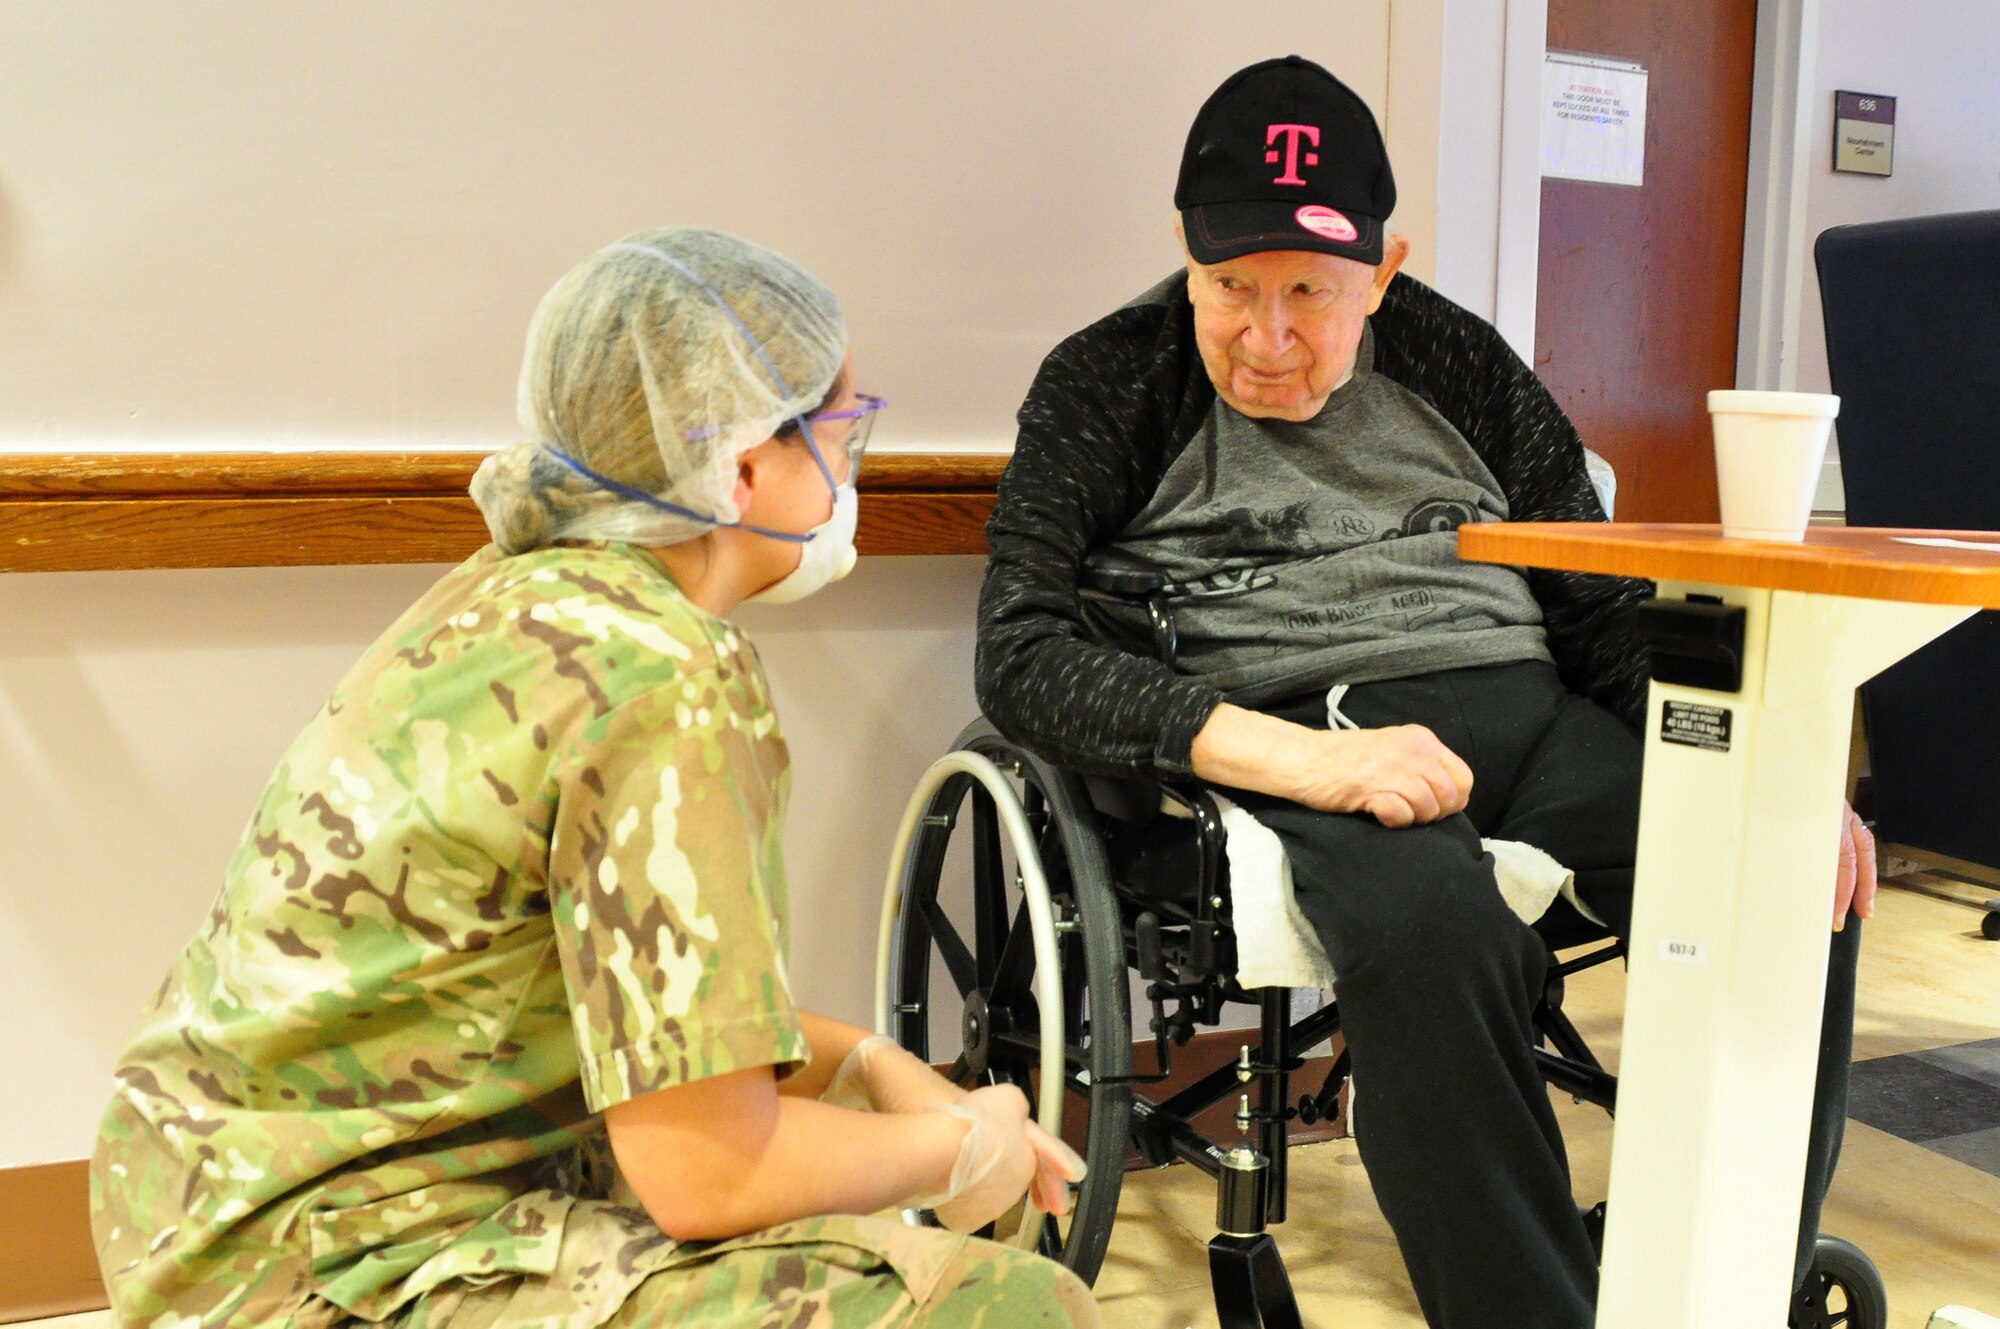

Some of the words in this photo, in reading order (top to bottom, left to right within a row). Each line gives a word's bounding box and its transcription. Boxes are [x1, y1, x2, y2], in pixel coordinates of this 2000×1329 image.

[1577, 94, 1594, 102] DOOR
[1595, 96, 1612, 104] MUST
[1552, 101, 1567, 109] KEPT
[1568, 103, 1591, 112] LOCKED
[1592, 105, 1600, 113] AT
[1557, 111, 1569, 119] FOR
[1265, 124, 1320, 186] T
[1391, 589, 1430, 610] AGED
[1693, 704, 1724, 716] CAPACITY
[1677, 719, 1693, 730] LBS
[1669, 943, 1697, 956] 637-2
